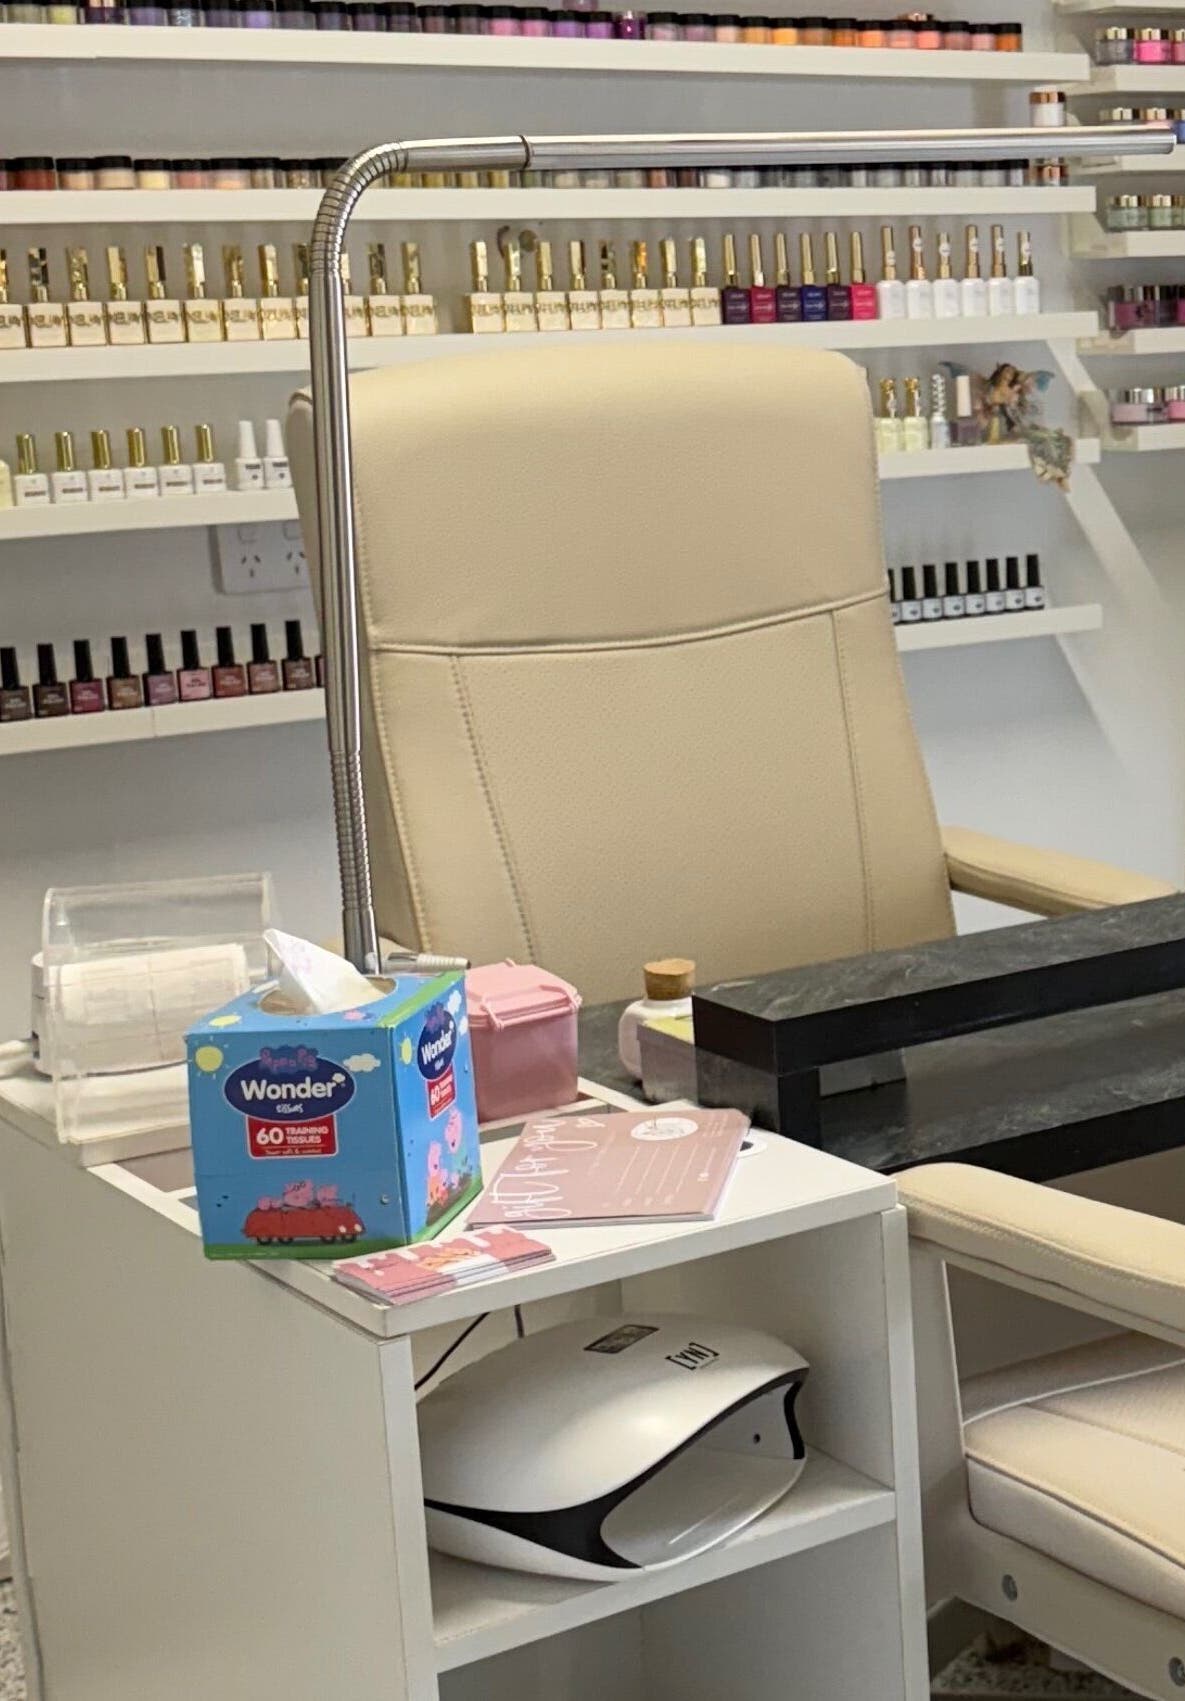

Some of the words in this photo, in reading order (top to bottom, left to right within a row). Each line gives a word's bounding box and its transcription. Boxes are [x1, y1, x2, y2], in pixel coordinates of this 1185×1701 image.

[240, 1076, 337, 1101] Wonder
[256, 1126, 284, 1145] 60
[285, 1126, 329, 1136] TRAINING
[286, 1135, 322, 1145] TISSUES
[522, 1119, 598, 1152] you
[500, 1154, 570, 1179] for
[488, 1181, 573, 1219] gift
